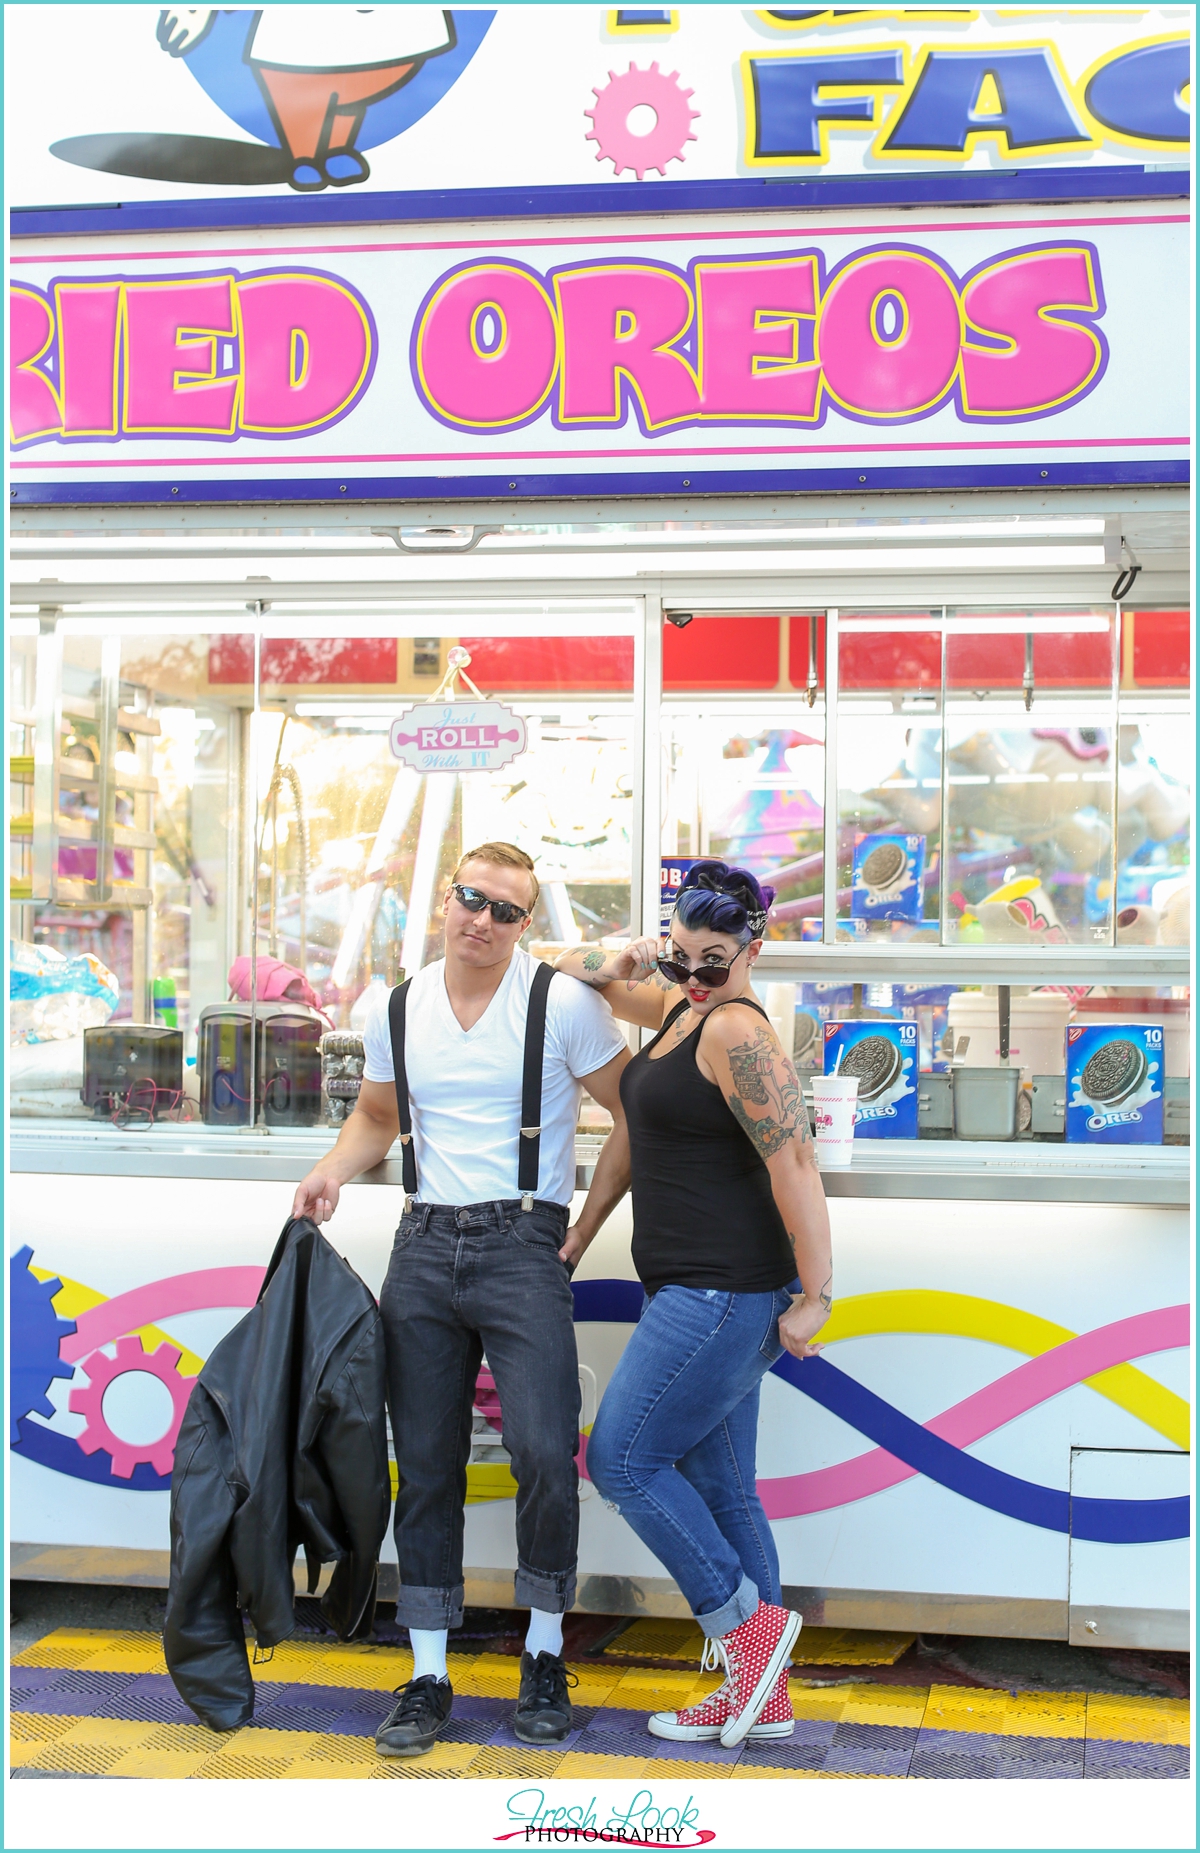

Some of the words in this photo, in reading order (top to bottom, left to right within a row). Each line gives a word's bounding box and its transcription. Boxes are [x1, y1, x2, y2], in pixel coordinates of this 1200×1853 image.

[411, 241, 1109, 437] OREOS
[433, 707, 476, 730] Just
[421, 728, 495, 748] ROLL
[422, 754, 463, 768] With
[471, 751, 490, 767] IT
[905, 837, 918, 847] 10
[898, 1025, 917, 1039] 10
[1143, 1029, 1162, 1043] 10
[1087, 1111, 1141, 1130] OREO
